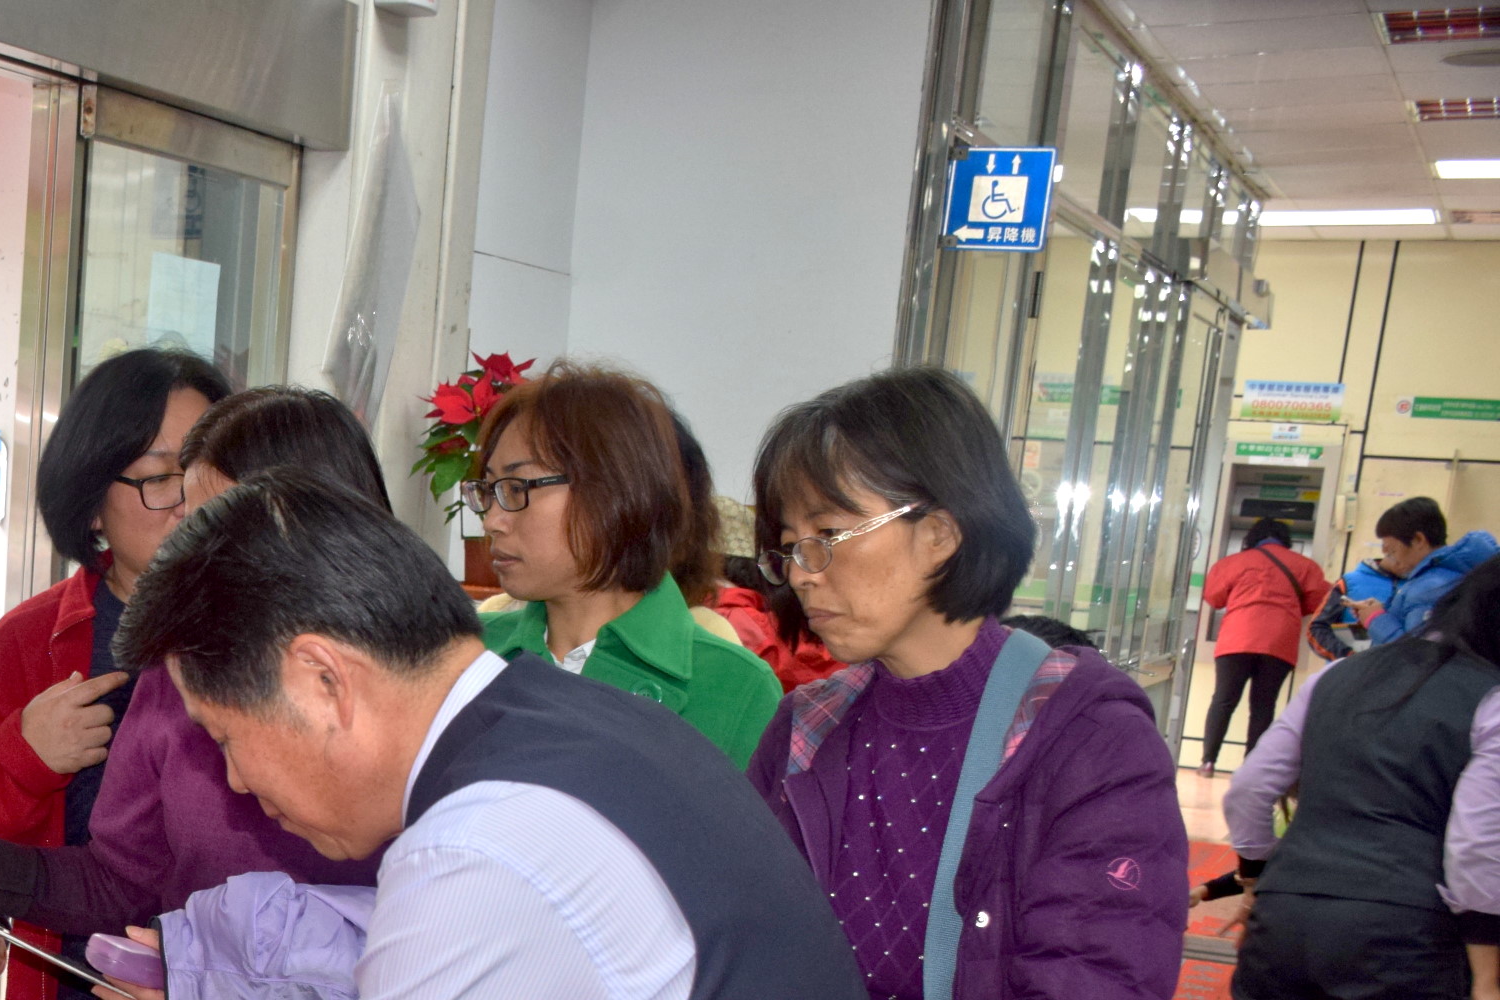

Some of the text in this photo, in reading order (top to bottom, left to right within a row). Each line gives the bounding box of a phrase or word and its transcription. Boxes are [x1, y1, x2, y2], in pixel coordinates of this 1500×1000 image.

[987, 226, 1036, 243] 昇降機
[1252, 400, 1332, 412] 0800700365
